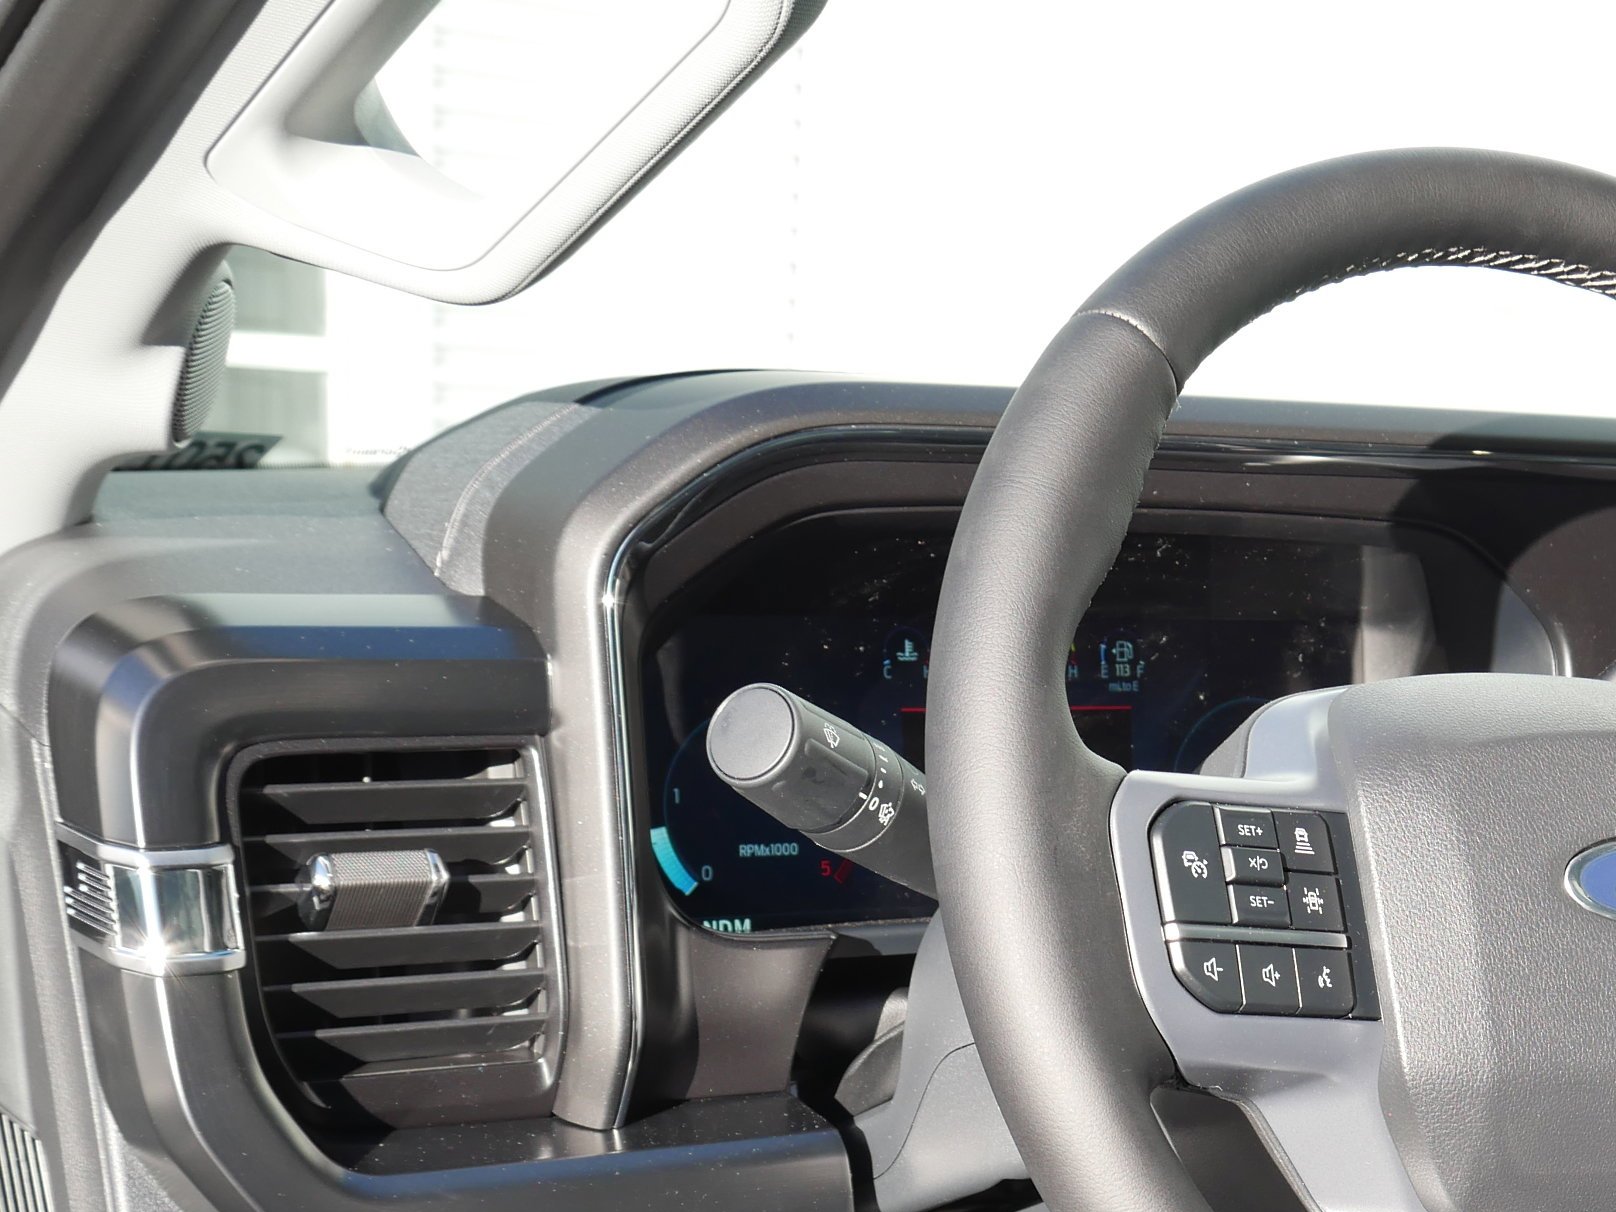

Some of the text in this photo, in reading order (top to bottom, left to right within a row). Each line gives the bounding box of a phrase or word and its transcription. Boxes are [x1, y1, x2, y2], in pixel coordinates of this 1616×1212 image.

[883, 665, 893, 679] C
[1068, 665, 1078, 678] H
[1101, 663, 1145, 678] E 113 F
[673, 788, 680, 804] 1
[1237, 825, 1264, 836] SET+
[738, 842, 800, 858] RPMx1000
[701, 865, 713, 881] 0
[820, 860, 832, 876] 5
